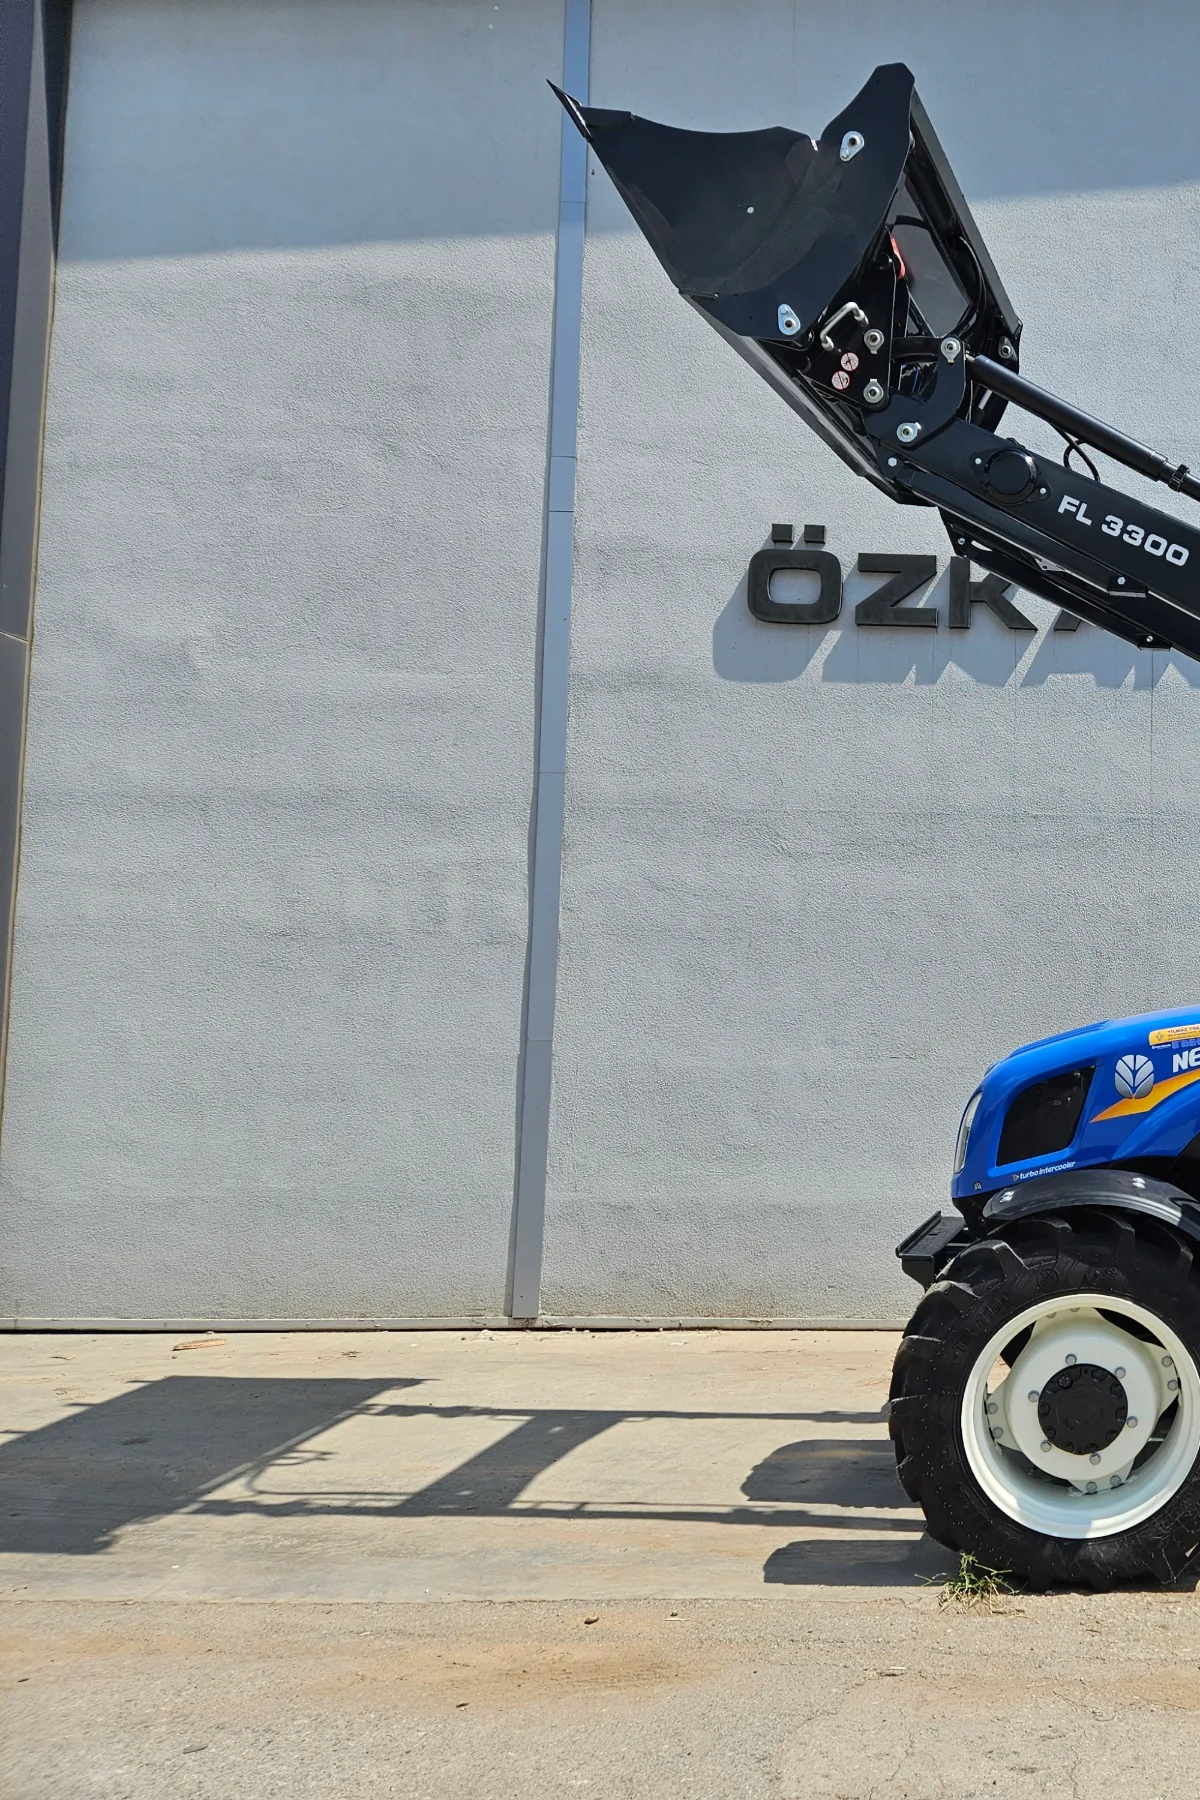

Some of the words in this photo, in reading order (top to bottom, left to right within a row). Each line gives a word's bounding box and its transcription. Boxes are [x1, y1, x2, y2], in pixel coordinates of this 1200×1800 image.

[1057, 494, 1093, 526] FL
[1101, 514, 1190, 567] 3300
[748, 523, 1082, 632] ÖZK
[1020, 1171, 1038, 1179] turbo
[1039, 1161, 1076, 1175] intercooler
